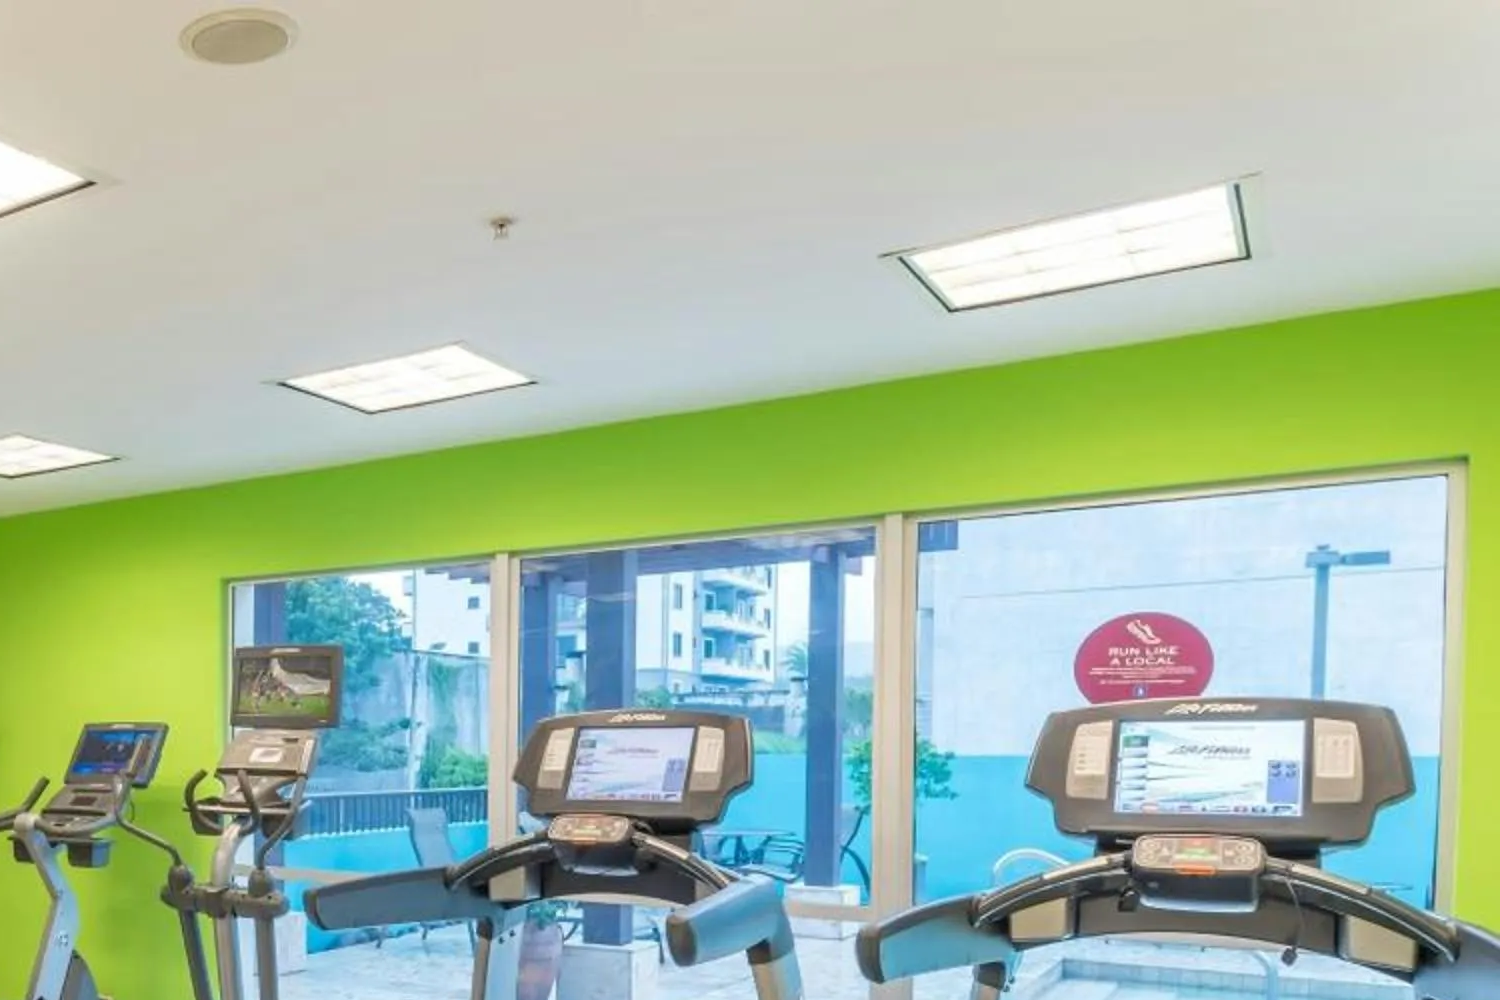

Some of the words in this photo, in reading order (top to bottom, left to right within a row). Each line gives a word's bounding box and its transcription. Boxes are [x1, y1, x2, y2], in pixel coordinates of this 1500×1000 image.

[1108, 647, 1141, 657] RUN
[1145, 645, 1179, 656] LIKE
[1110, 657, 1121, 666] A
[1125, 657, 1175, 666] LOCAL
